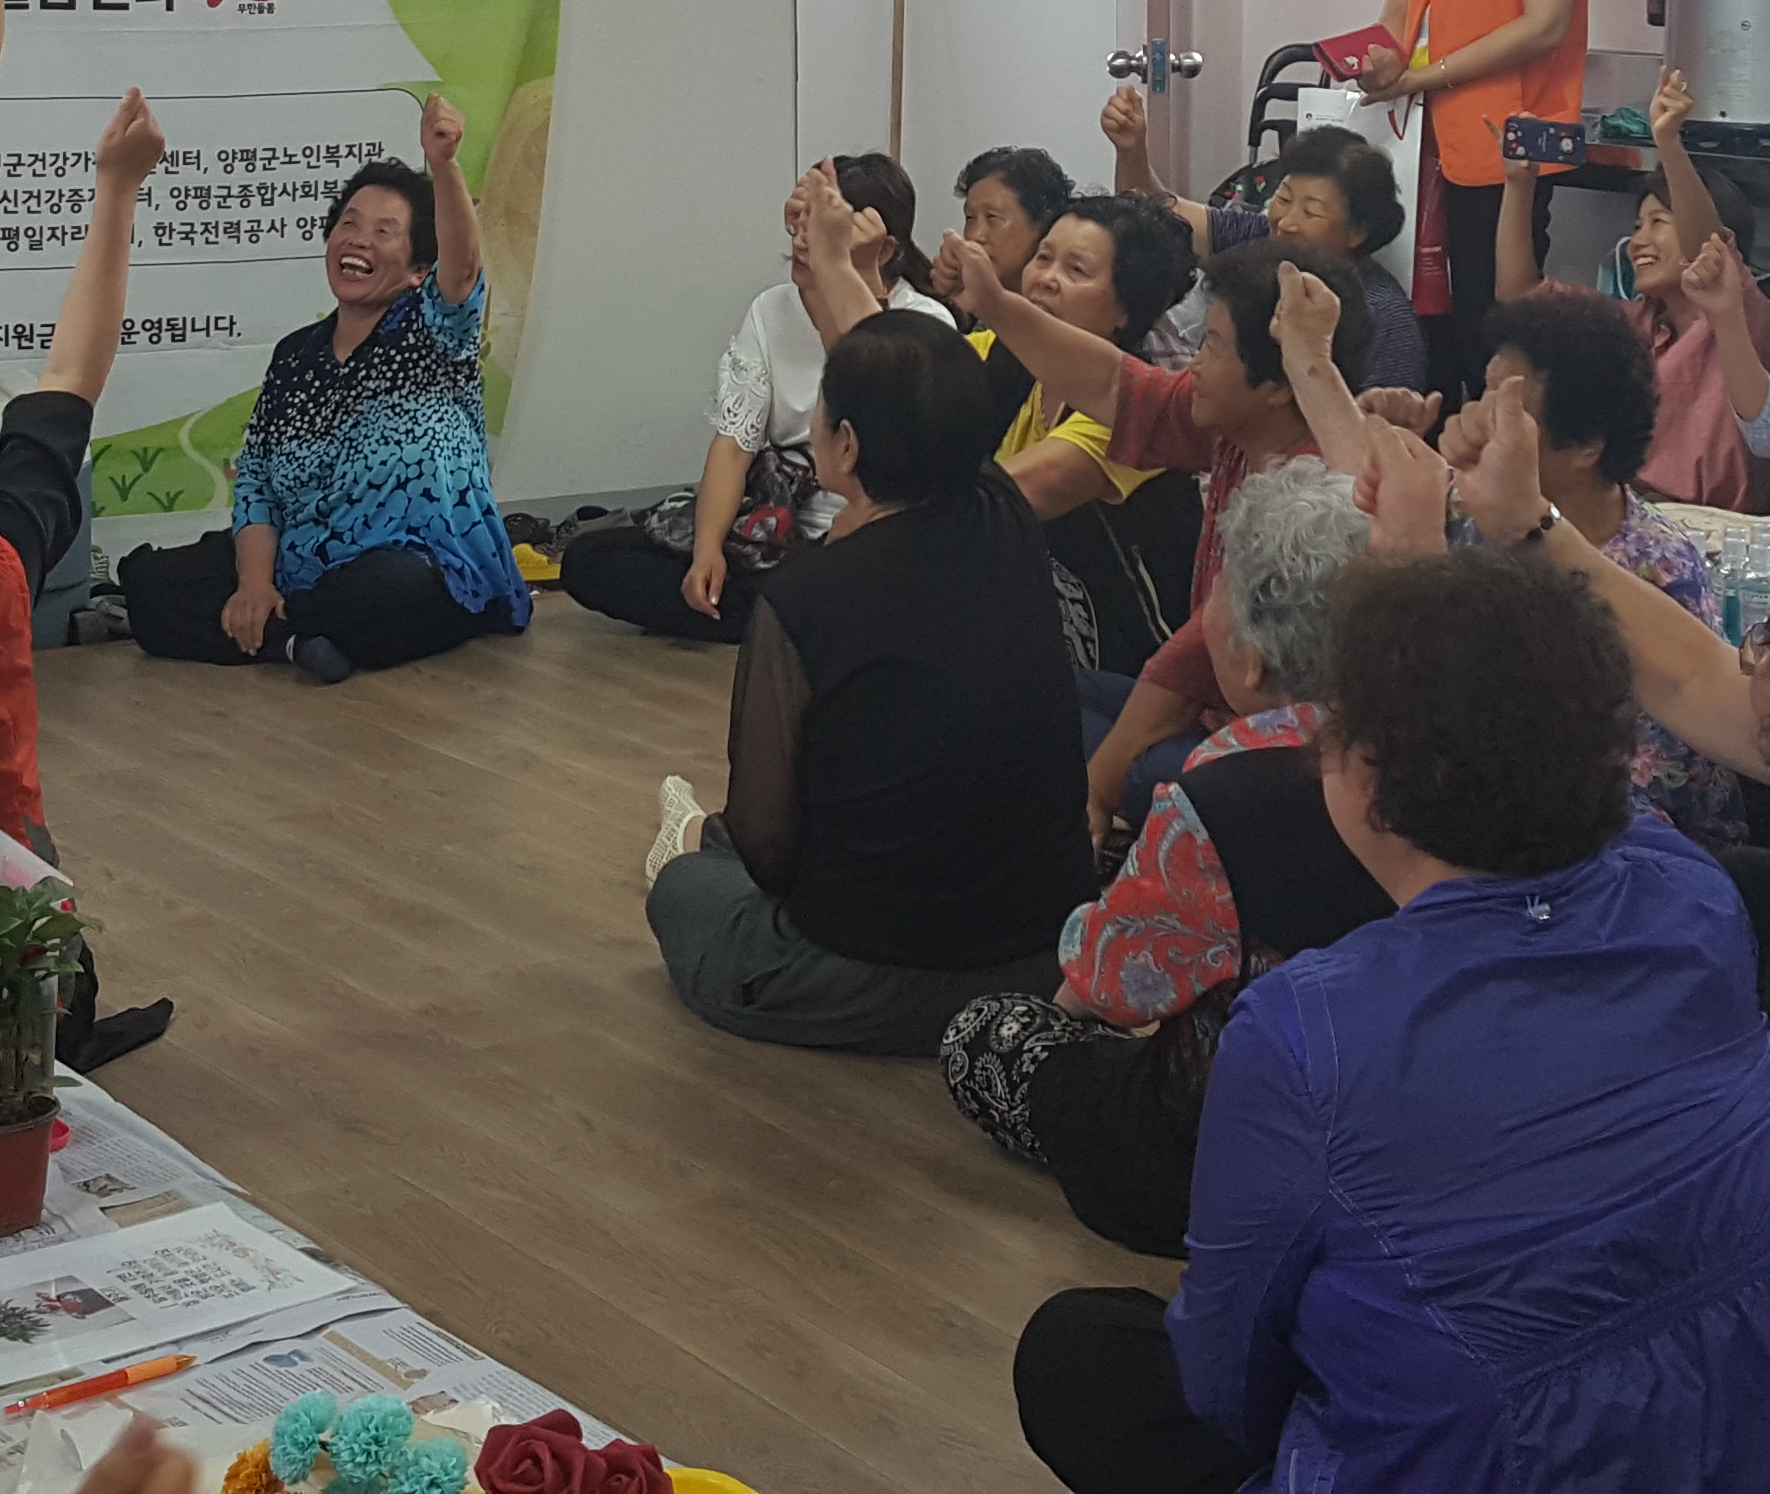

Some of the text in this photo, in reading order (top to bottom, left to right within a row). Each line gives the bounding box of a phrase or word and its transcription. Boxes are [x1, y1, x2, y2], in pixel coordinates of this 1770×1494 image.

[237, 3, 276, 15] 무한돌봄
[153, 216, 288, 247] 한국전력공사
[119, 313, 243, 348] 운영됩니다.
